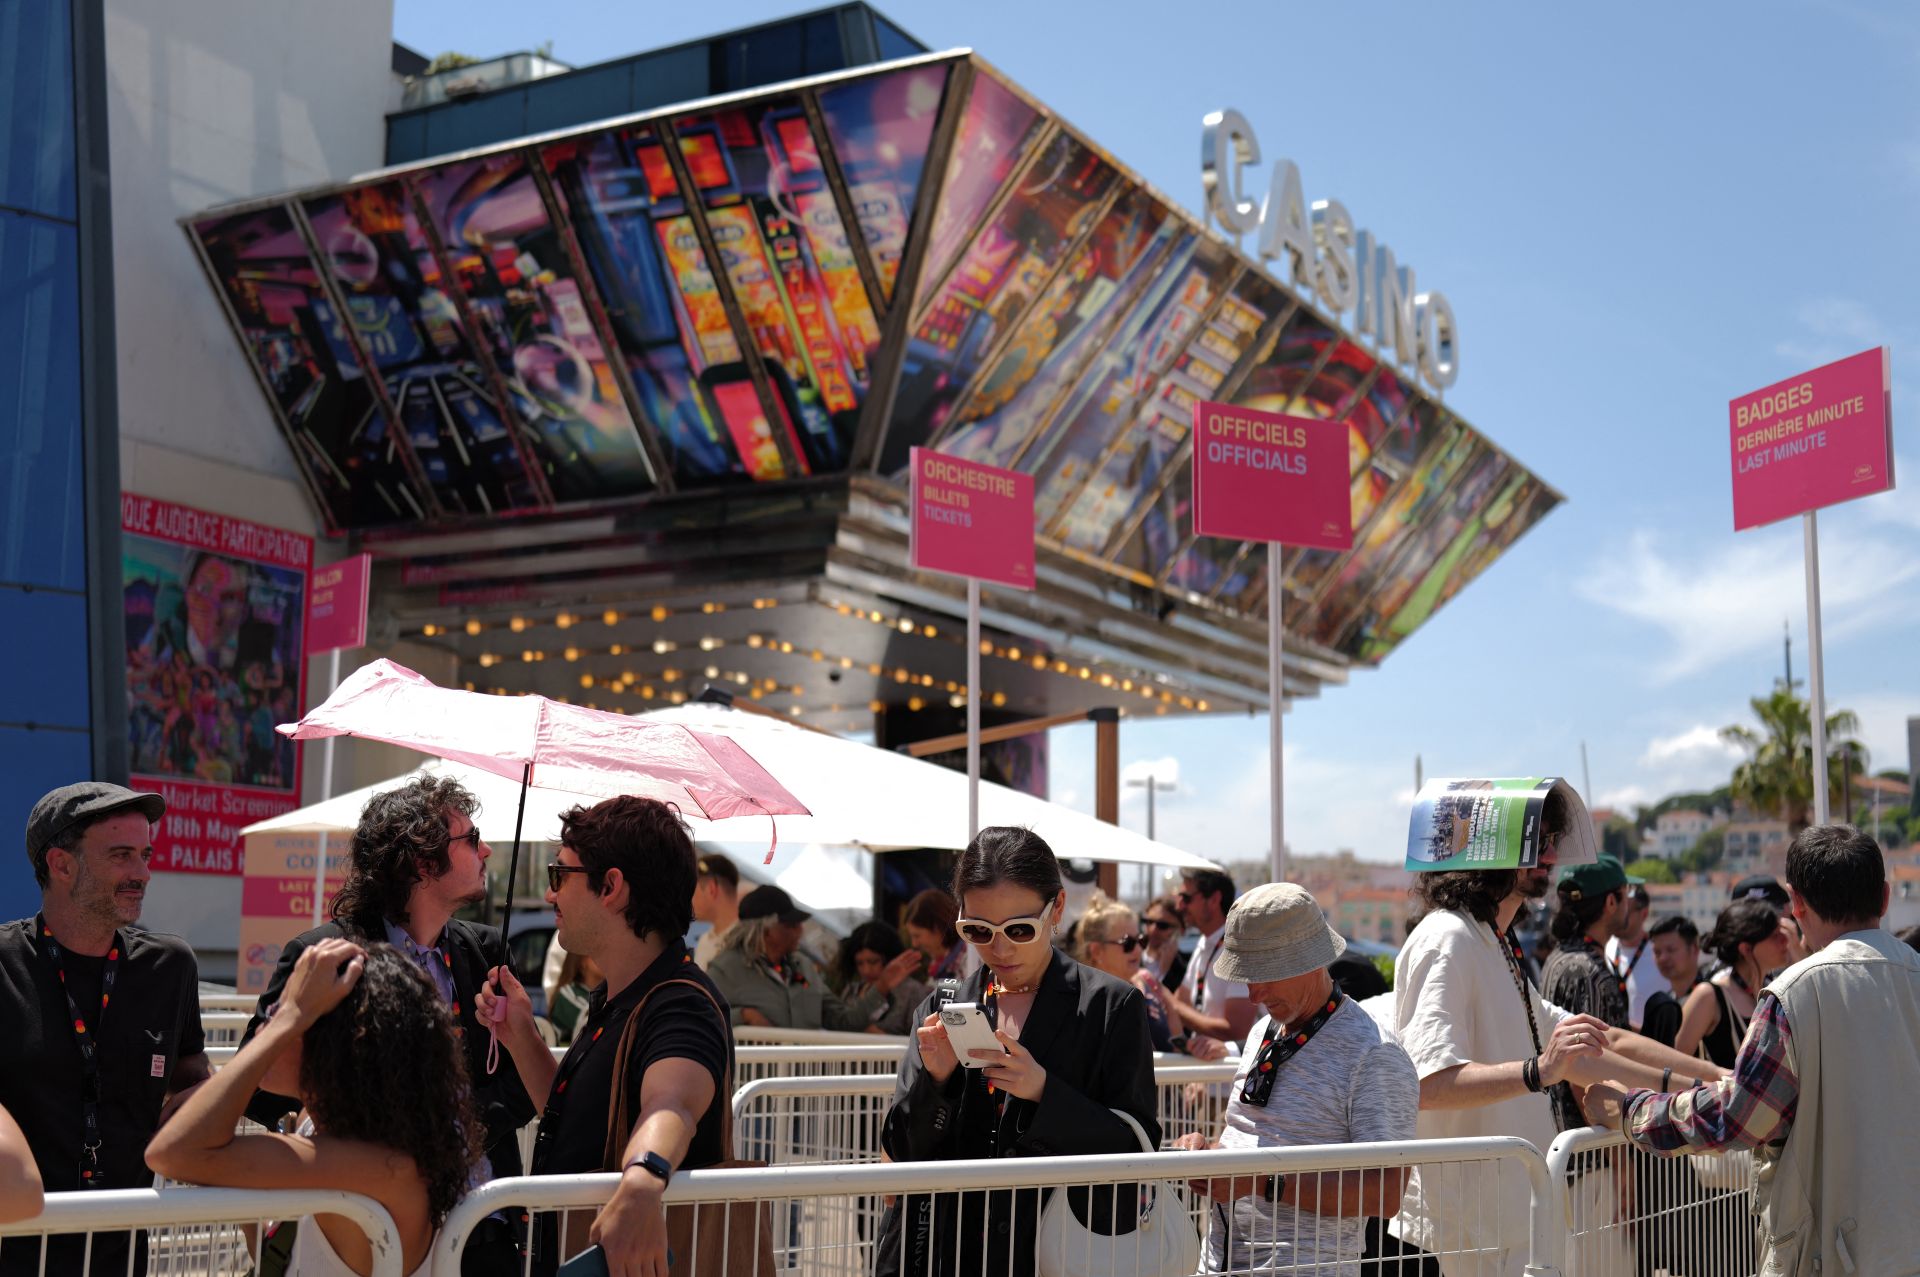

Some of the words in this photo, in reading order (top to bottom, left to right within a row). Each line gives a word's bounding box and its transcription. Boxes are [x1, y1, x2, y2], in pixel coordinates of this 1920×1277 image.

[1202, 108, 1459, 390] CASINO
[1736, 382, 1813, 428] BADGES
[1208, 414, 1307, 448] OFFICIELS
[1737, 415, 1804, 452] DERNIÈRE
[1807, 396, 1864, 429] MINUTE
[1207, 441, 1308, 475] OFFICIALS
[1738, 449, 1771, 474] LAST
[1774, 431, 1827, 462] MINUTE
[924, 458, 1016, 499] ORCHESTRE
[923, 485, 970, 509] BILLETS
[923, 503, 972, 528] TICKETS
[154, 504, 219, 546] AUDIENCE
[221, 520, 309, 565] PARTICIPATION
[162, 784, 218, 813] Market
[166, 815, 201, 839] 18th
[206, 818, 240, 848] May
[1476, 805, 1486, 836] CREWS
[1483, 799, 1495, 832] WHERE
[171, 845, 233, 872] PALAIS
[1466, 843, 1474, 862] THE
[1473, 839, 1481, 861] BEST
[1480, 833, 1489, 861] RIGHT
[1488, 836, 1497, 861] NEED
